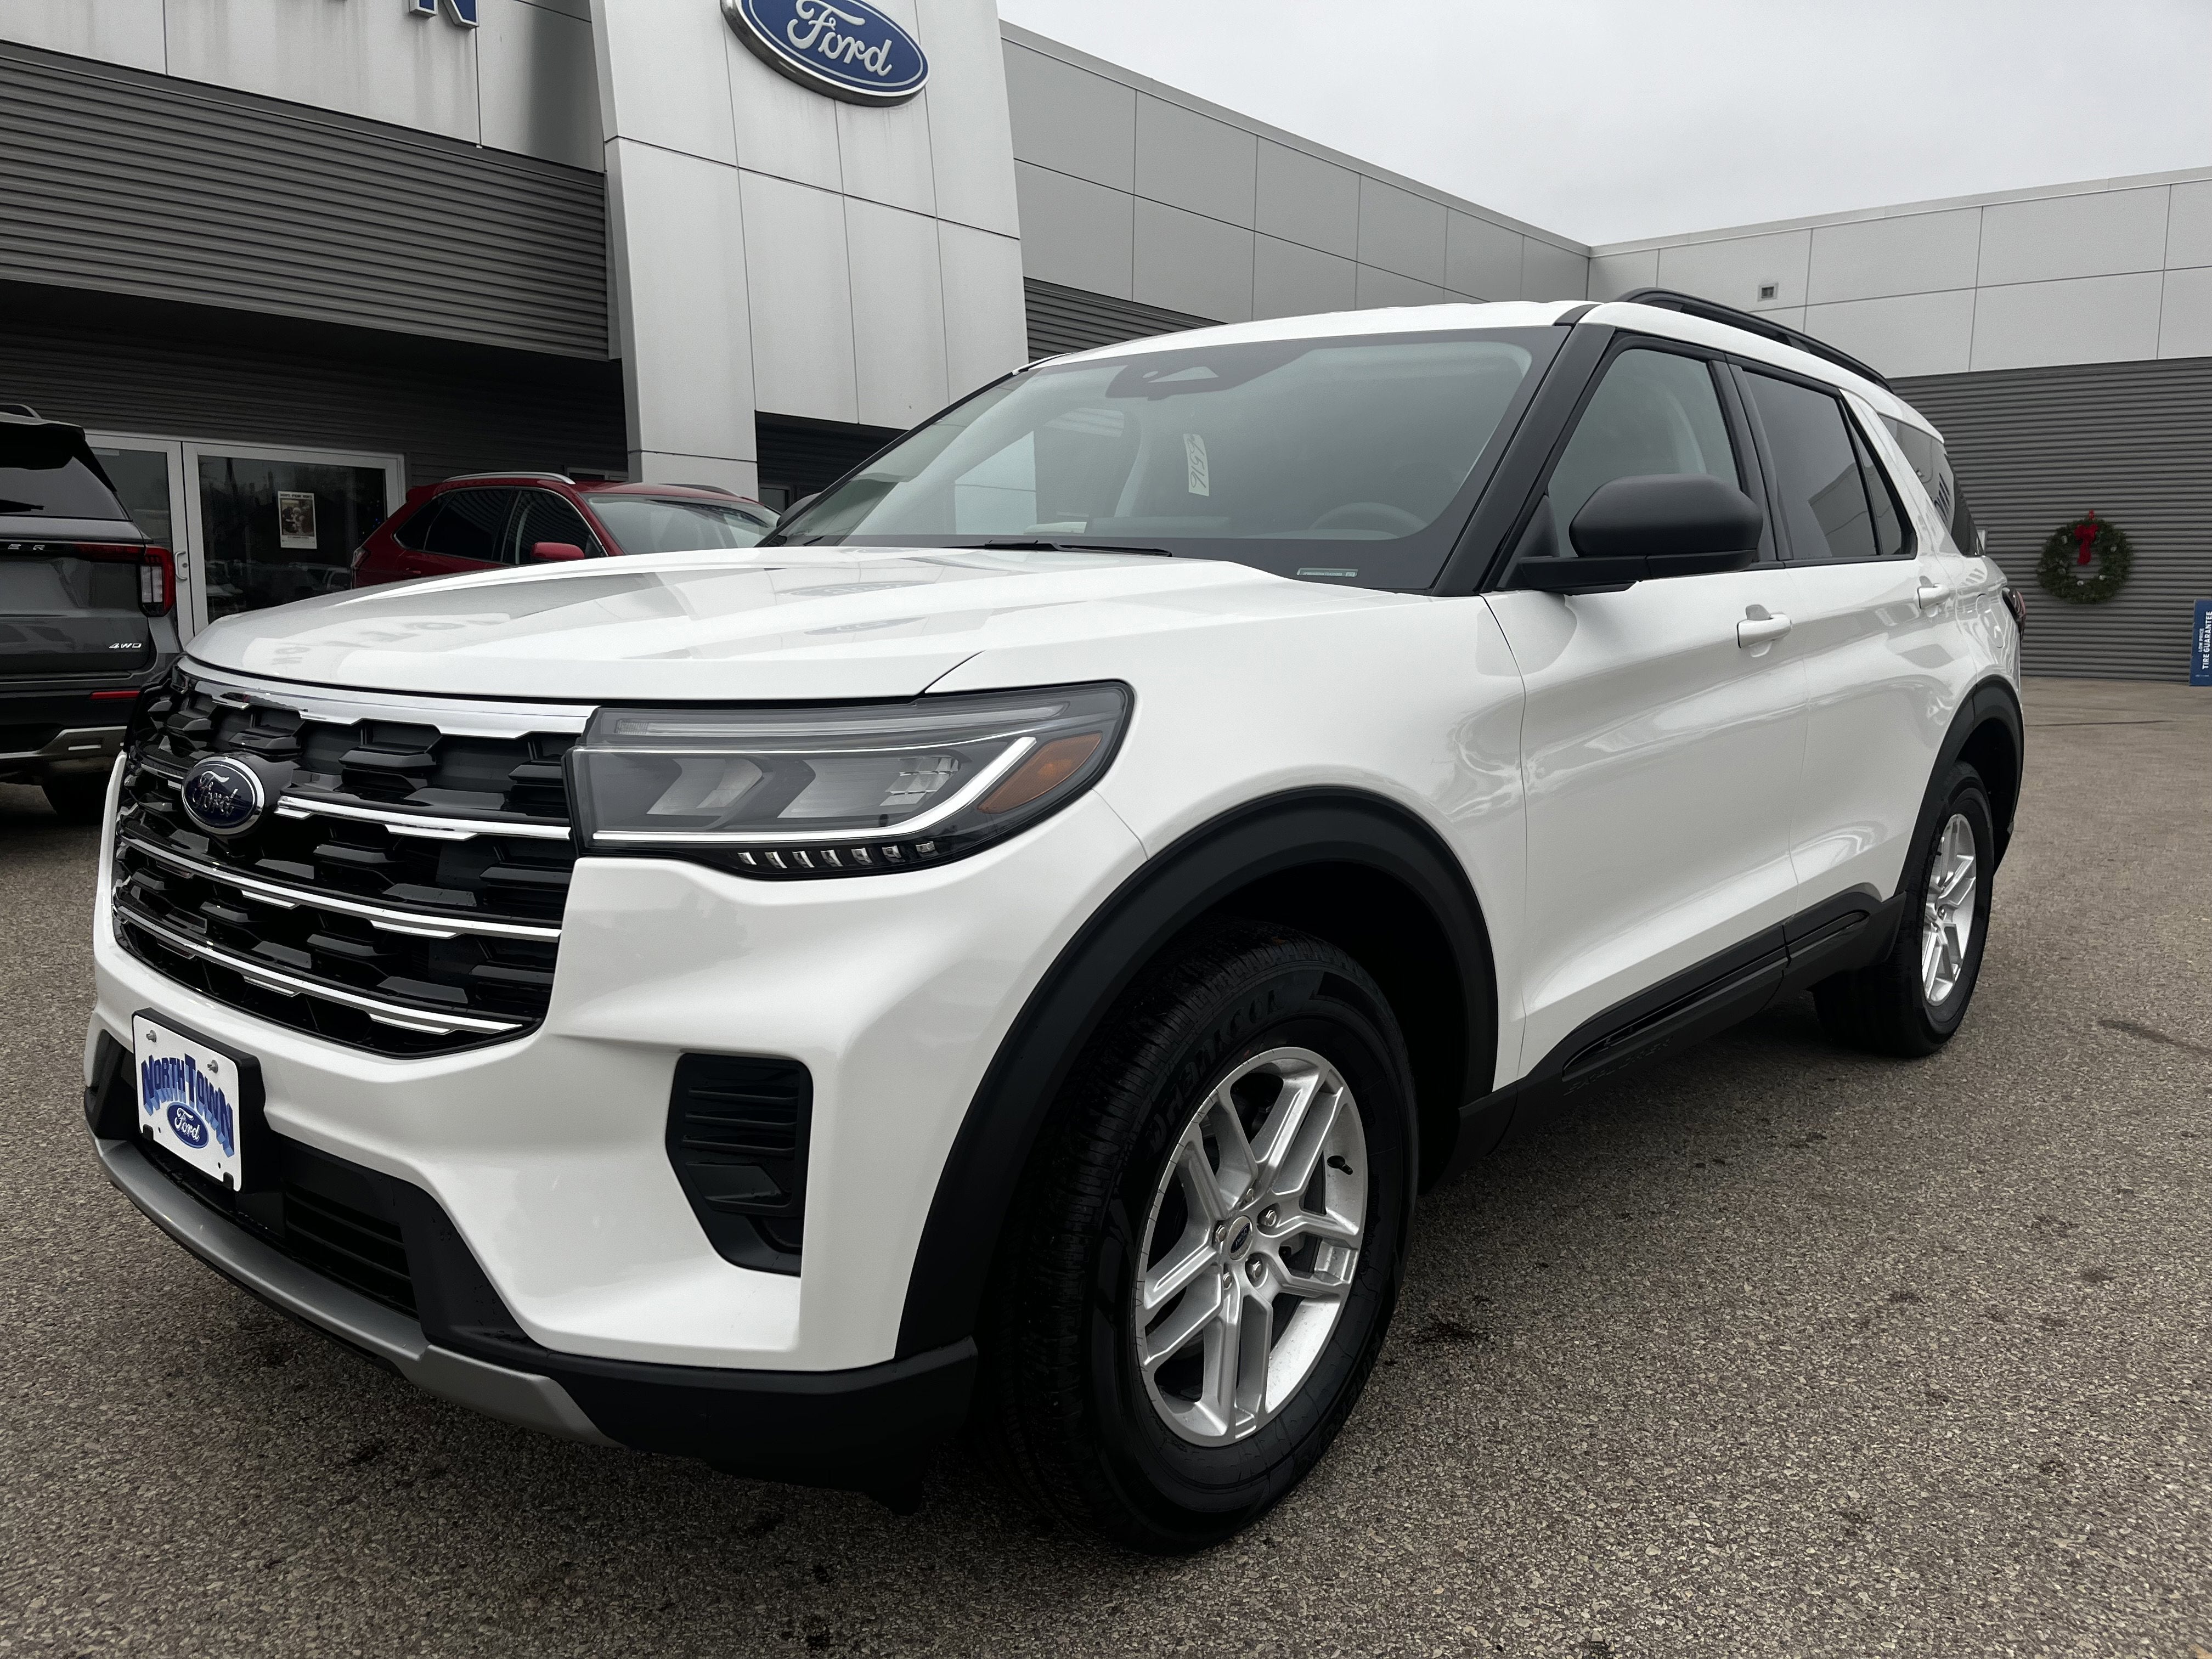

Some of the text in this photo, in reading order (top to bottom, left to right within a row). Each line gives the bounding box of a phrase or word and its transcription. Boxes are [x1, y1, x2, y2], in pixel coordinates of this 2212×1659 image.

[787, 0, 893, 77] Ford
[2203, 611, 2212, 653] GUARANTEE
[192, 770, 239, 817] Ford
[174, 1107, 201, 1142] Ford
